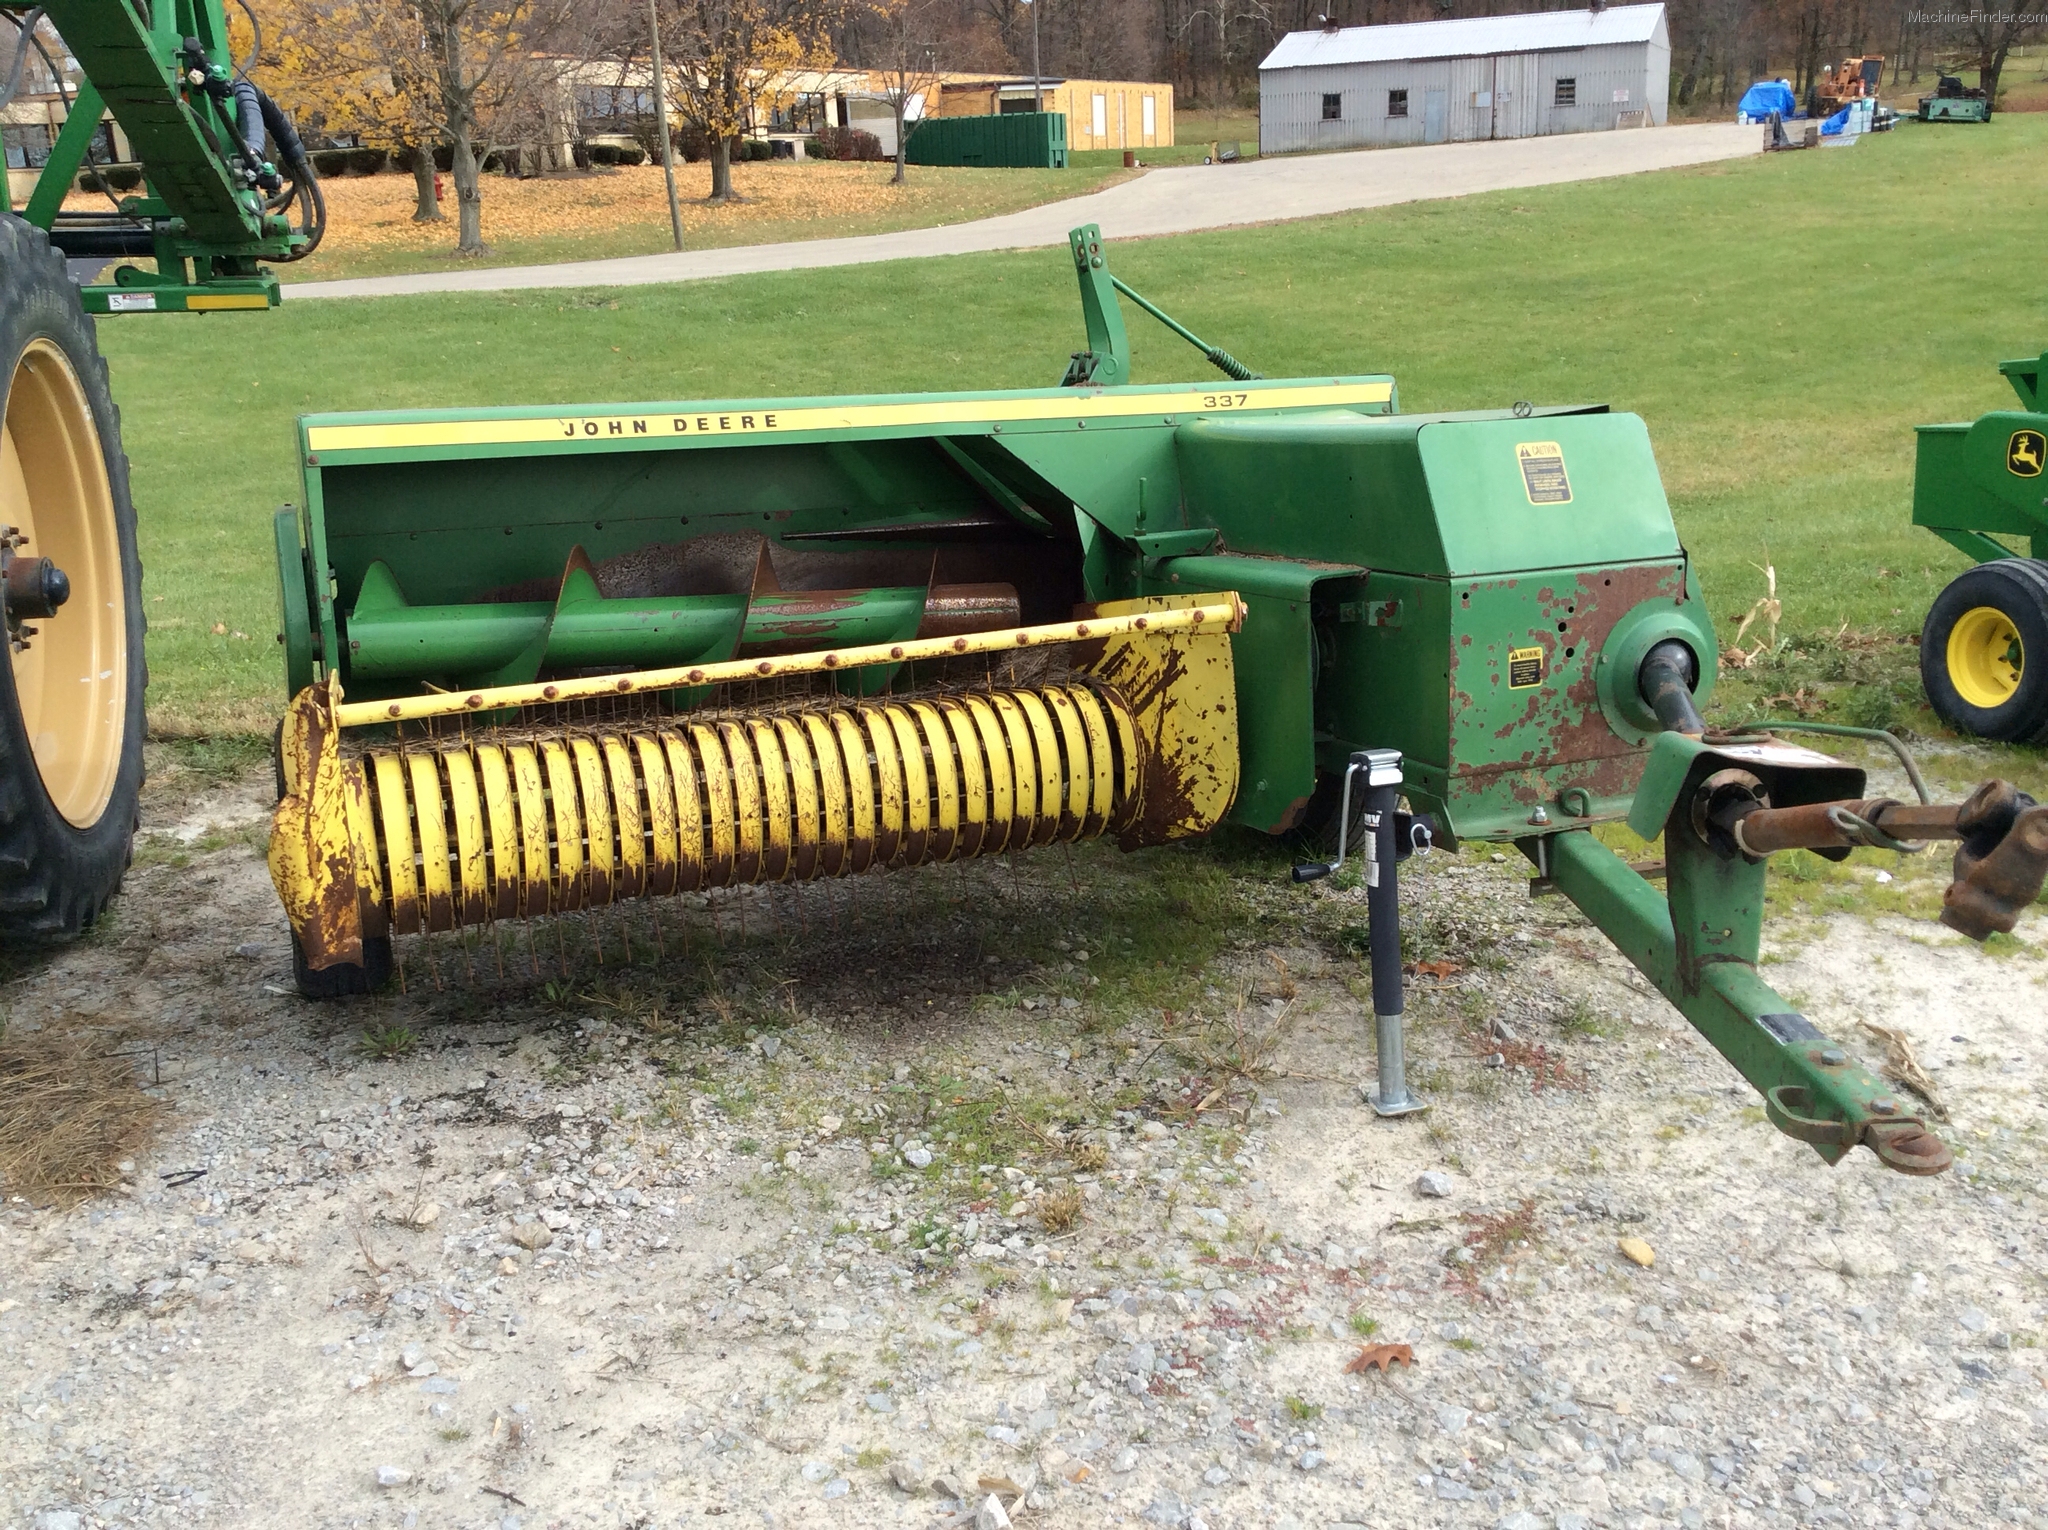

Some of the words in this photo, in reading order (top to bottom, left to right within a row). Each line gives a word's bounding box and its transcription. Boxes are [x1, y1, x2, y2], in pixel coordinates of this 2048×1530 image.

[1203, 394, 1248, 408] 337
[563, 419, 647, 437] JOHN
[673, 414, 778, 432] DEERE
[1531, 444, 1558, 456] CAUTION
[1519, 649, 1541, 659] WARNING
